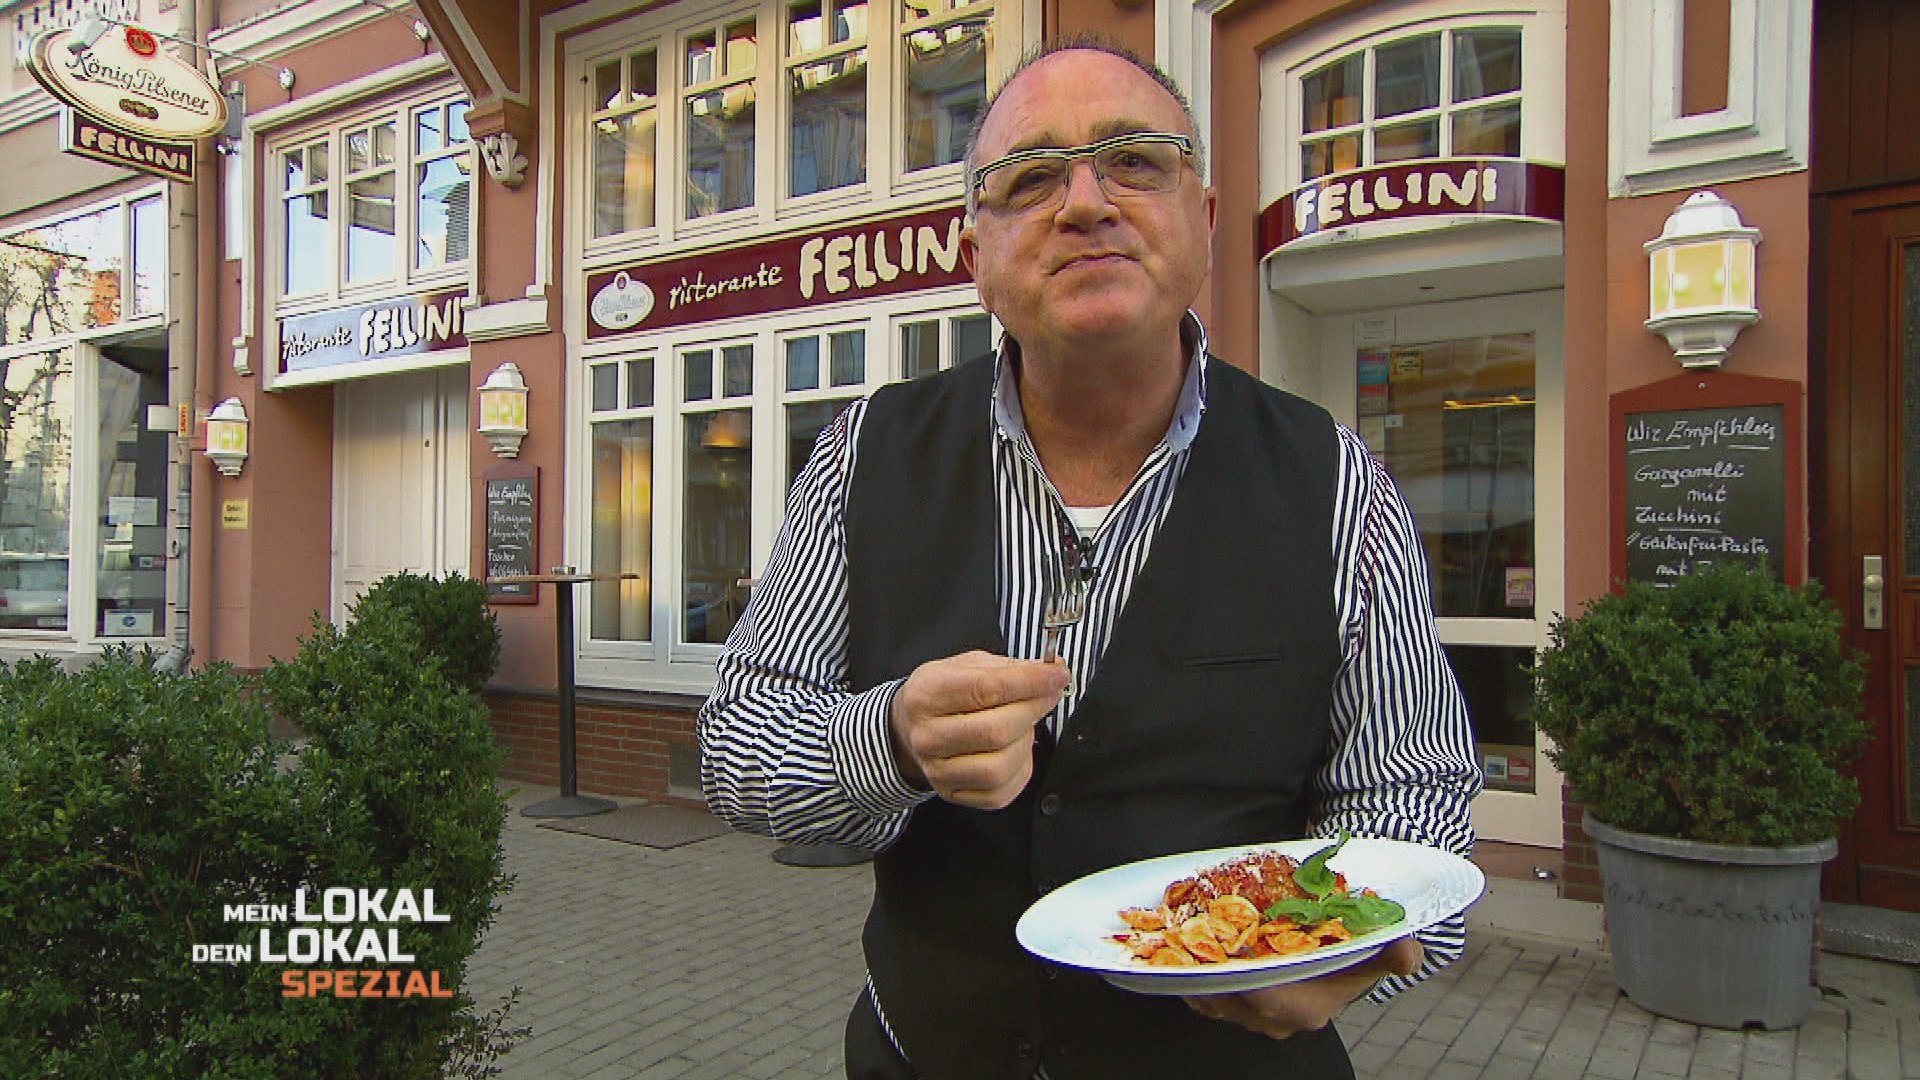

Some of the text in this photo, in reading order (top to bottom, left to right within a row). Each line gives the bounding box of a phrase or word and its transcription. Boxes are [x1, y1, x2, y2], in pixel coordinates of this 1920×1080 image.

[80, 127, 187, 171] FELLINI
[1294, 168, 1498, 232] FELLINI
[668, 217, 966, 310] ristorante FELLIN
[359, 296, 462, 355] FELLINI
[1627, 421, 1660, 442] Wir
[1635, 506, 1722, 524] Zucchini
